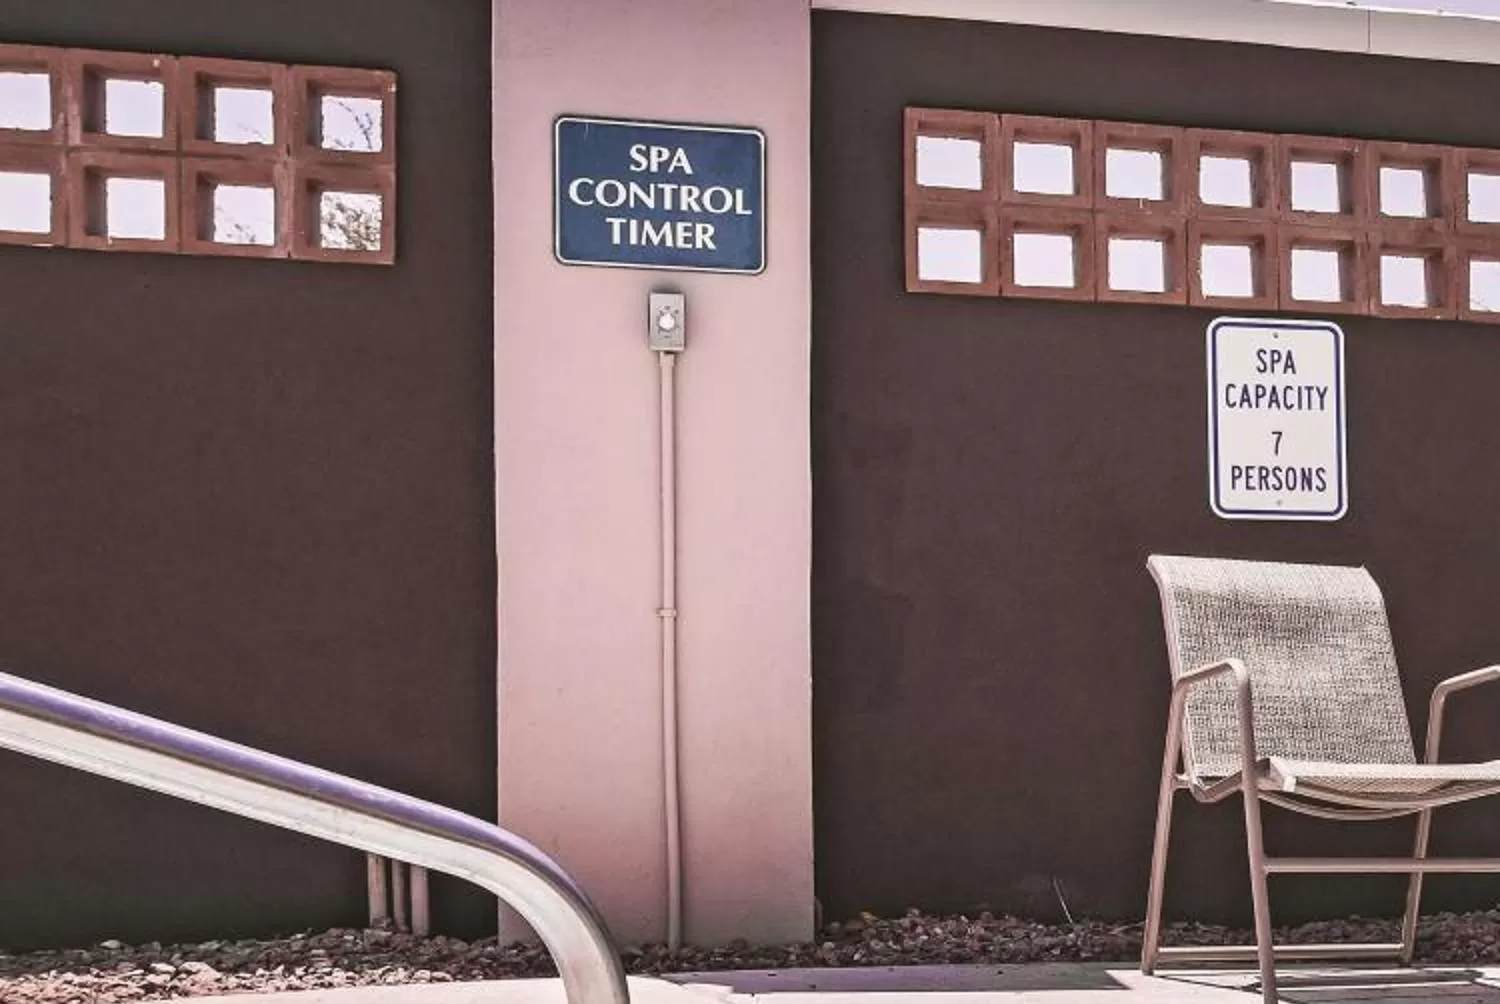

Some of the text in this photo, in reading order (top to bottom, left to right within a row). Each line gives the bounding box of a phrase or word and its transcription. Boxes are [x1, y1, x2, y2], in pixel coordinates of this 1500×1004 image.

[629, 144, 694, 175] SPA
[568, 177, 753, 216] CONTROL
[605, 217, 717, 250] TIMER
[1256, 348, 1297, 375] SPA
[1225, 383, 1329, 411] CAPACITY
[1271, 430, 1284, 457] 7
[1231, 465, 1328, 493] PERSONS
